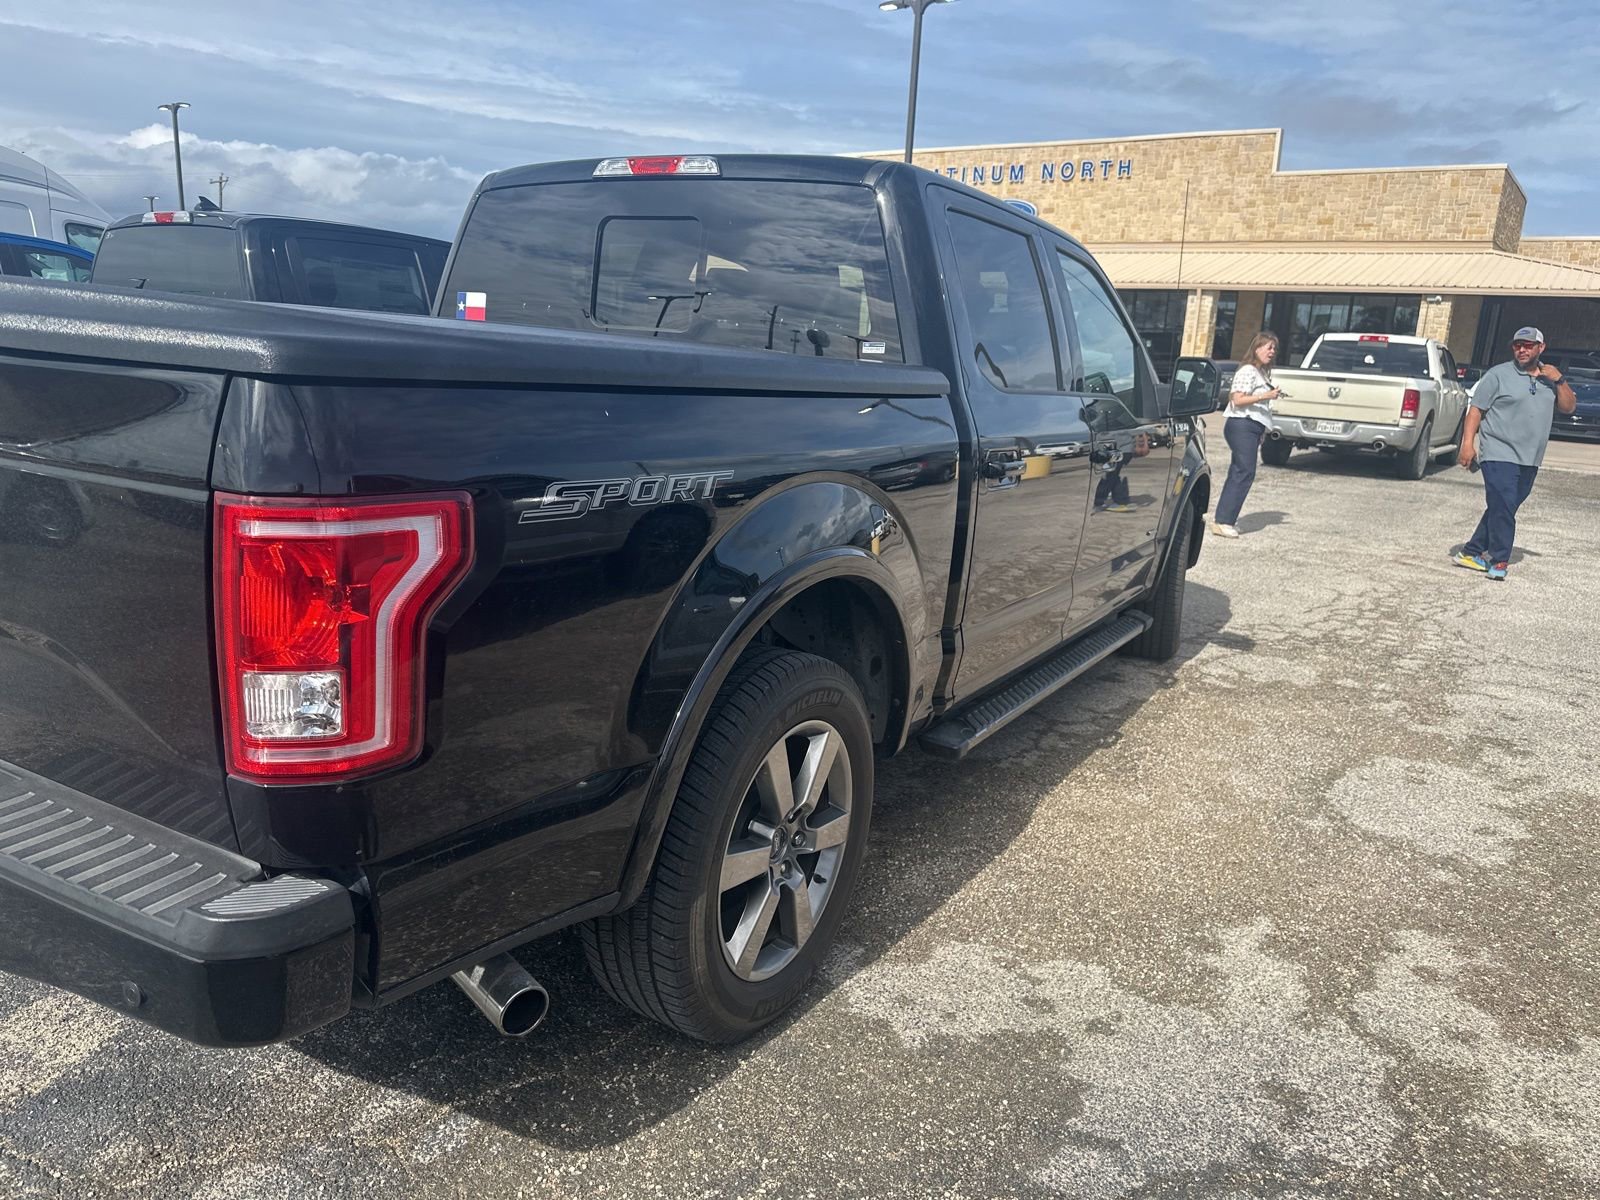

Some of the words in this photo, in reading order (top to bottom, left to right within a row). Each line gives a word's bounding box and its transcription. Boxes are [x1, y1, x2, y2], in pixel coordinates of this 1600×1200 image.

[934, 163, 1024, 185] TINUM
[1041, 159, 1132, 182] NORTH
[518, 470, 735, 524] SPORT
